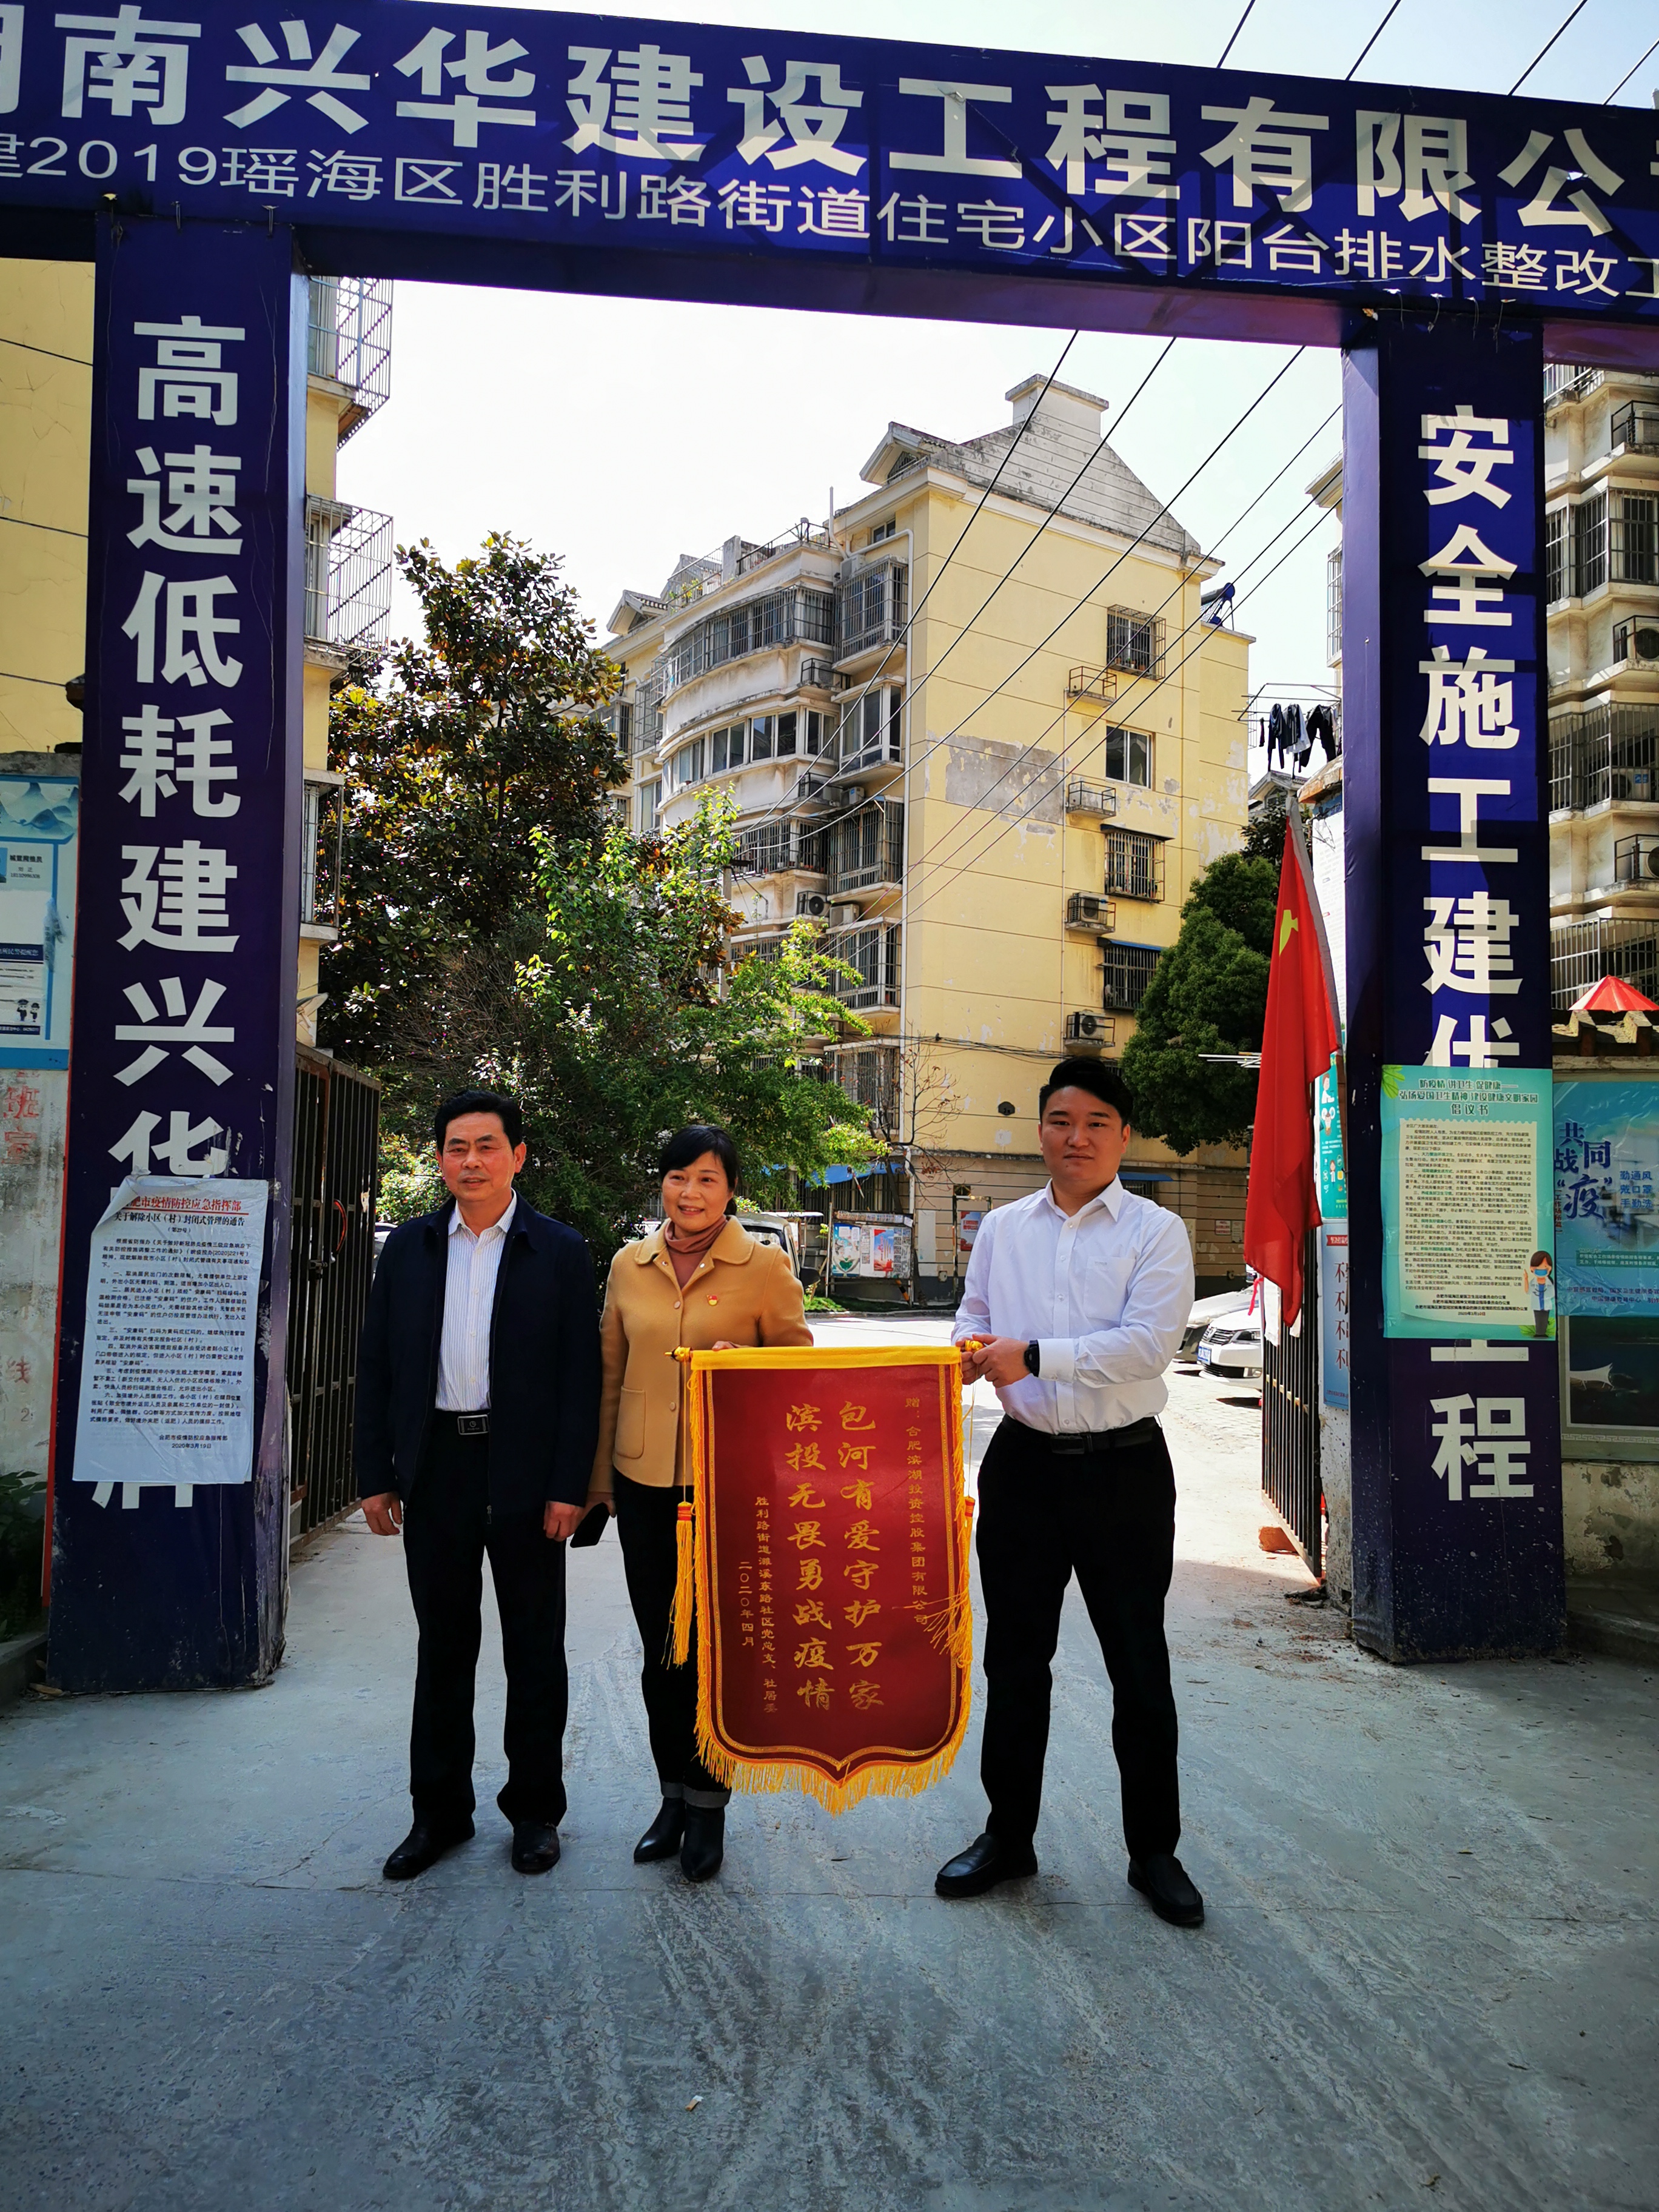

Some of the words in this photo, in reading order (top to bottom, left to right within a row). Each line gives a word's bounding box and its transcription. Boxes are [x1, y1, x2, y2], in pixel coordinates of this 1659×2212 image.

[0, 4, 1659, 236] 南兴华建设工程有限公
[1419, 1079, 1445, 1088] 防疫情
[1448, 1080, 1473, 1089] 讲卫生
[1399, 1091, 1469, 1102] 弘扬爱国卫生精神
[1470, 1093, 1538, 1104] 建设健康文明家园
[1451, 1104, 1489, 1116] 倡议书
[1620, 1170, 1653, 1181] 勤通风
[1620, 1184, 1652, 1195] 戴口罩
[124, 1196, 242, 1212] 肥市疫情防控应急指挥部
[1620, 1198, 1654, 1208] 手勤洗
[905, 1397, 928, 1625] 赠：合肥滨湖投资控股集团有限公司
[785, 1403, 835, 1712] 滨投无畏勇战疫情
[838, 1401, 883, 1711] 包河有爱守护万家
